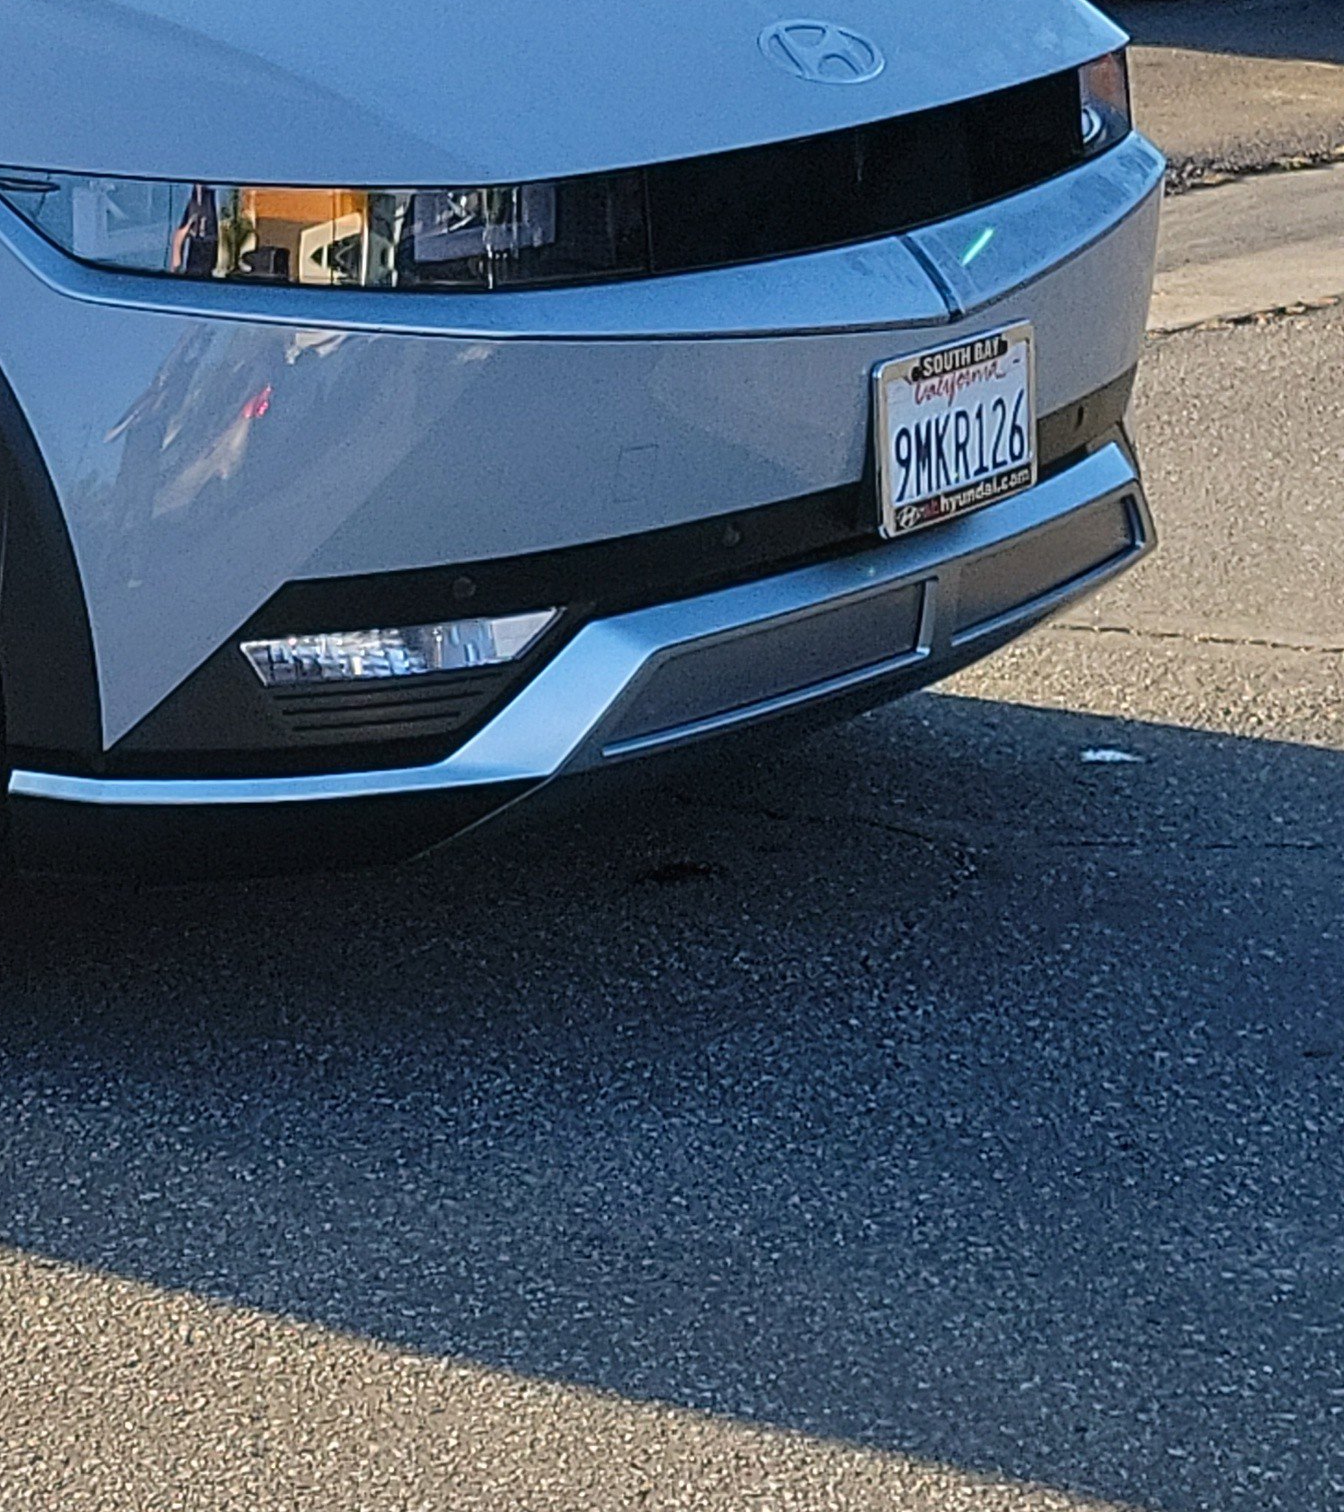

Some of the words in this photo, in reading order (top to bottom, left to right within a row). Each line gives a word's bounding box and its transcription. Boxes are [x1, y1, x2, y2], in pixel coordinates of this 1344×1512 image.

[923, 346, 971, 377] SOUTH
[974, 338, 1000, 361] BAY
[895, 389, 1025, 503] 9MKR126
